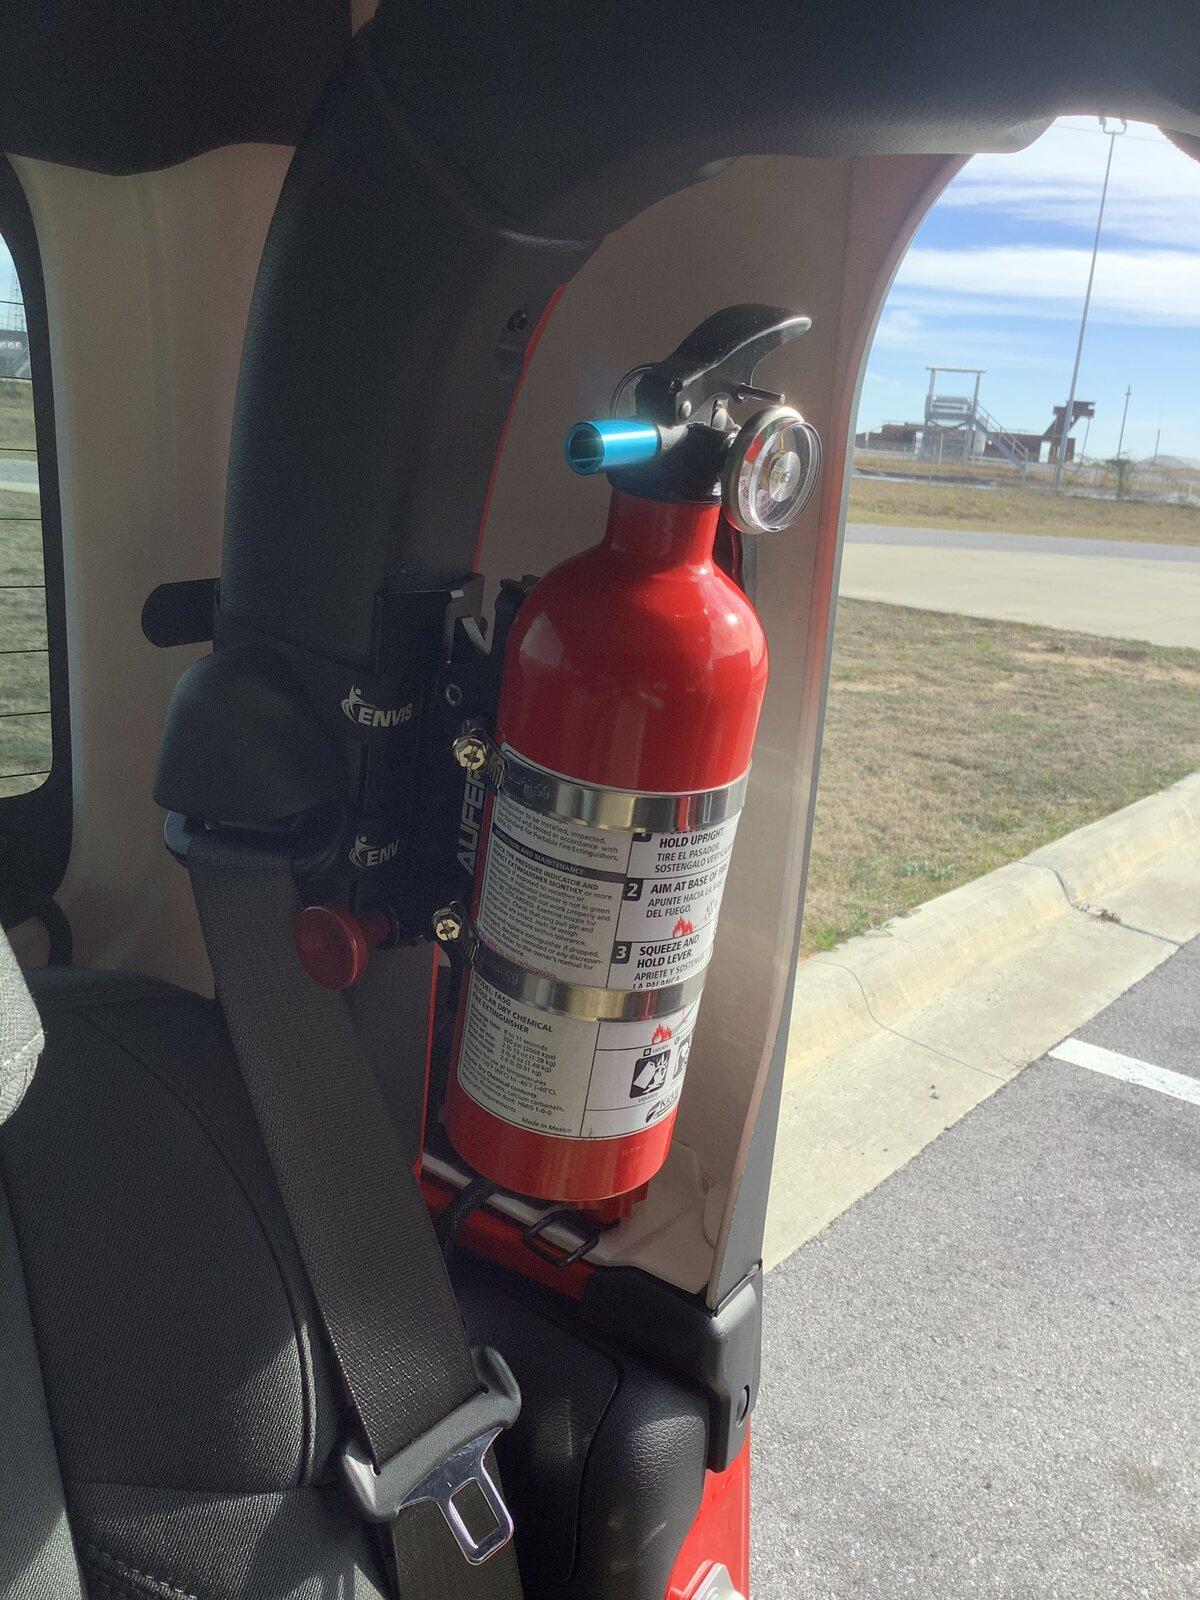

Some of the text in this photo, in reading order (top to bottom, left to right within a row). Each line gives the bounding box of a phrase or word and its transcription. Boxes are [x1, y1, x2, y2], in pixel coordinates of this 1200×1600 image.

[540, 820, 568, 834] installed,
[570, 831, 606, 843] inspected,
[533, 831, 558, 846] Portable
[559, 842, 571, 850] Fire
[572, 846, 618, 860] Extinguishers,
[560, 835, 598, 849] accordance
[660, 838, 688, 848] HOLD
[657, 853, 675, 861] TIRE
[678, 852, 687, 860] EL
[655, 858, 706, 873] SOSTENGALO
[543, 870, 580, 886] INDICATOR
[582, 882, 598, 890] AND
[549, 880, 583, 894] MONTHLY
[651, 884, 672, 893] AIM
[674, 881, 686, 892] AT
[688, 875, 708, 889] BASE
[548, 888, 574, 899] weather
[627, 883, 638, 897] 2
[538, 892, 560, 903] pointer
[648, 896, 681, 907] APUNTE
[536, 905, 562, 918] Examine
[563, 914, 584, 923] nozzle
[549, 903, 565, 912] work
[566, 909, 595, 919] properly
[646, 909, 662, 918] DEL
[541, 914, 553, 923] ring
[555, 919, 567, 927] pull
[568, 922, 579, 930] pin
[534, 926, 553, 937] within
[554, 933, 586, 946] tolerance.
[557, 927, 578, 937] weigh
[568, 946, 599, 957] dropped,
[616, 945, 627, 959] 3
[640, 934, 700, 956] SQUEEZE AND
[532, 949, 556, 962] owner's
[557, 958, 582, 967] manual
[556, 951, 567, 959] any
[568, 954, 603, 964] discrepan-
[637, 957, 665, 968] HOLD
[634, 969, 667, 981] APRIETE
[482, 1001, 528, 1033] EXTINGUISHER
[497, 1002, 510, 1015] DRY
[512, 1011, 553, 1032] CHEMICAL
[523, 1038, 547, 1050] seconds
[506, 1067, 546, 1086] temperatures
[486, 1070, 509, 1087] Chemical
[510, 1084, 536, 1098] contents
[517, 1100, 533, 1110] HMIS
[530, 1099, 564, 1112] carbonate,
[521, 1117, 539, 1126] Made
[548, 1125, 572, 1133] Mexico
